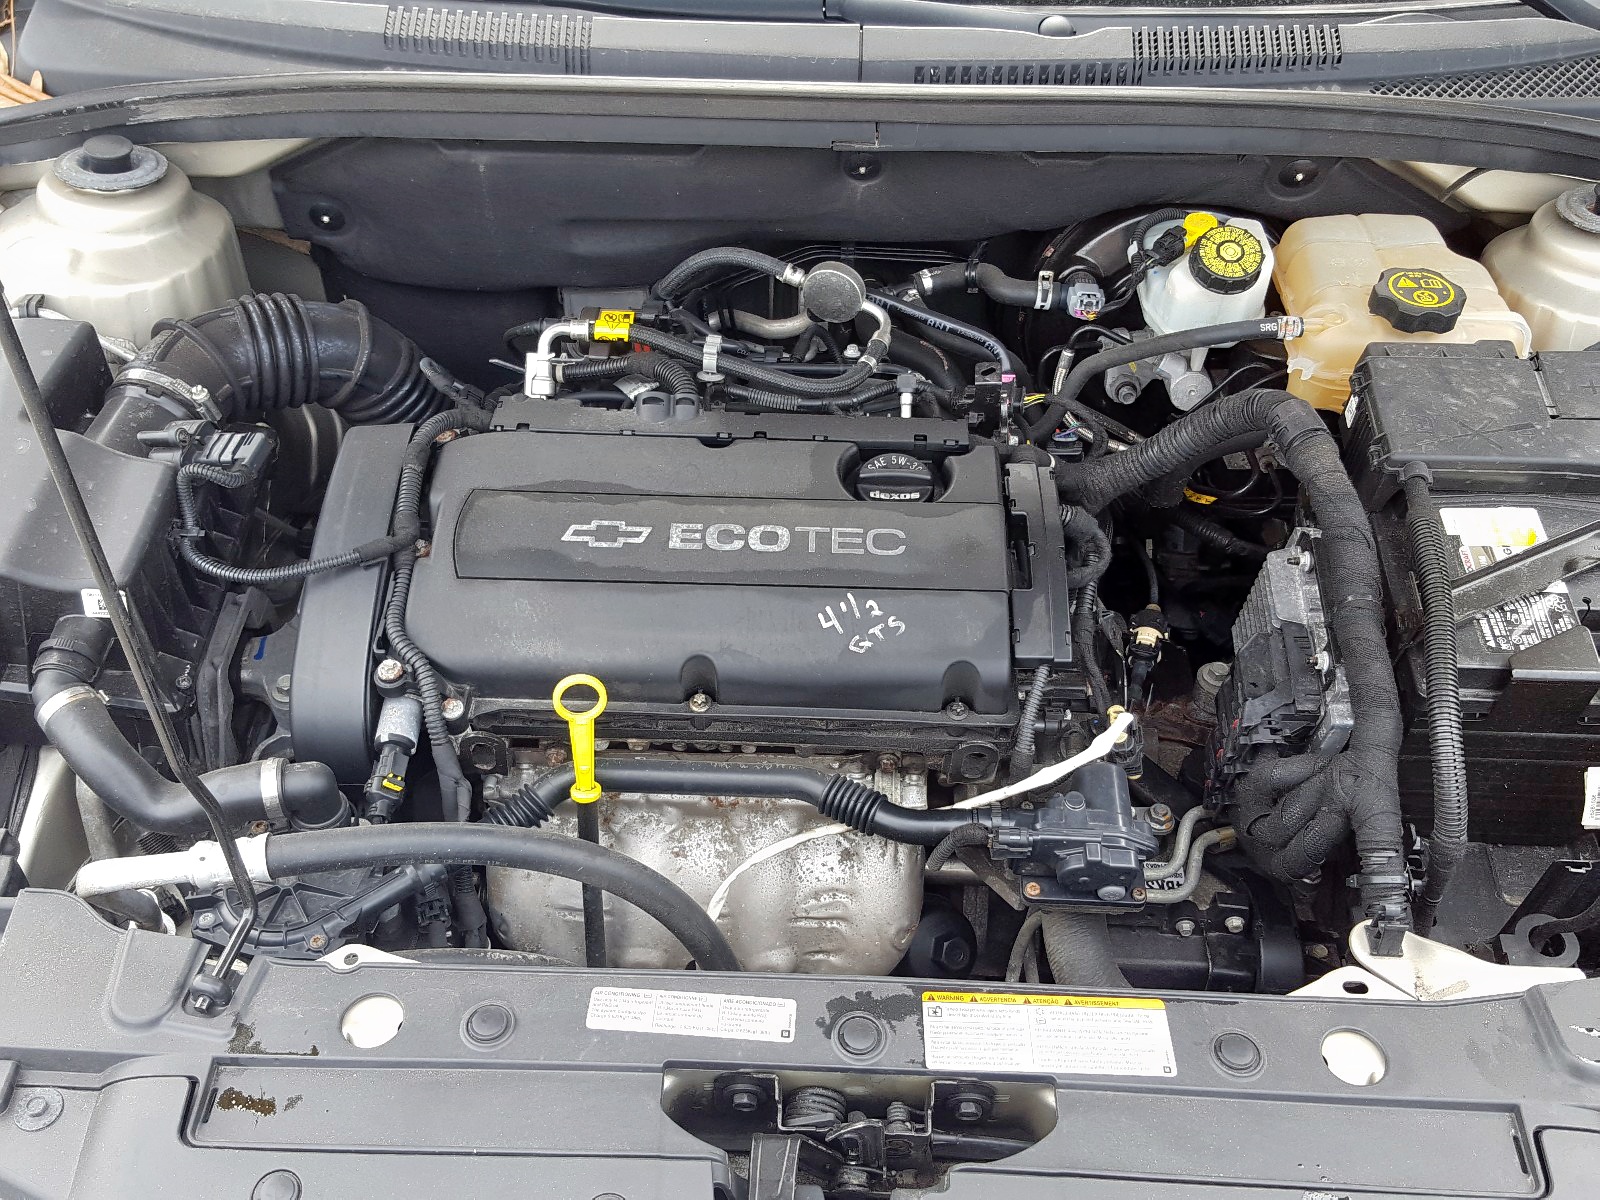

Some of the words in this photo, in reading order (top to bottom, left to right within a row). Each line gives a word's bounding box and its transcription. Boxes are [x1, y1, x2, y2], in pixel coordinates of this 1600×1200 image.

[927, 317, 950, 332] ANT
[1260, 322, 1278, 332] SRG
[869, 490, 920, 500] dexos
[668, 522, 907, 556] ECOTEC
